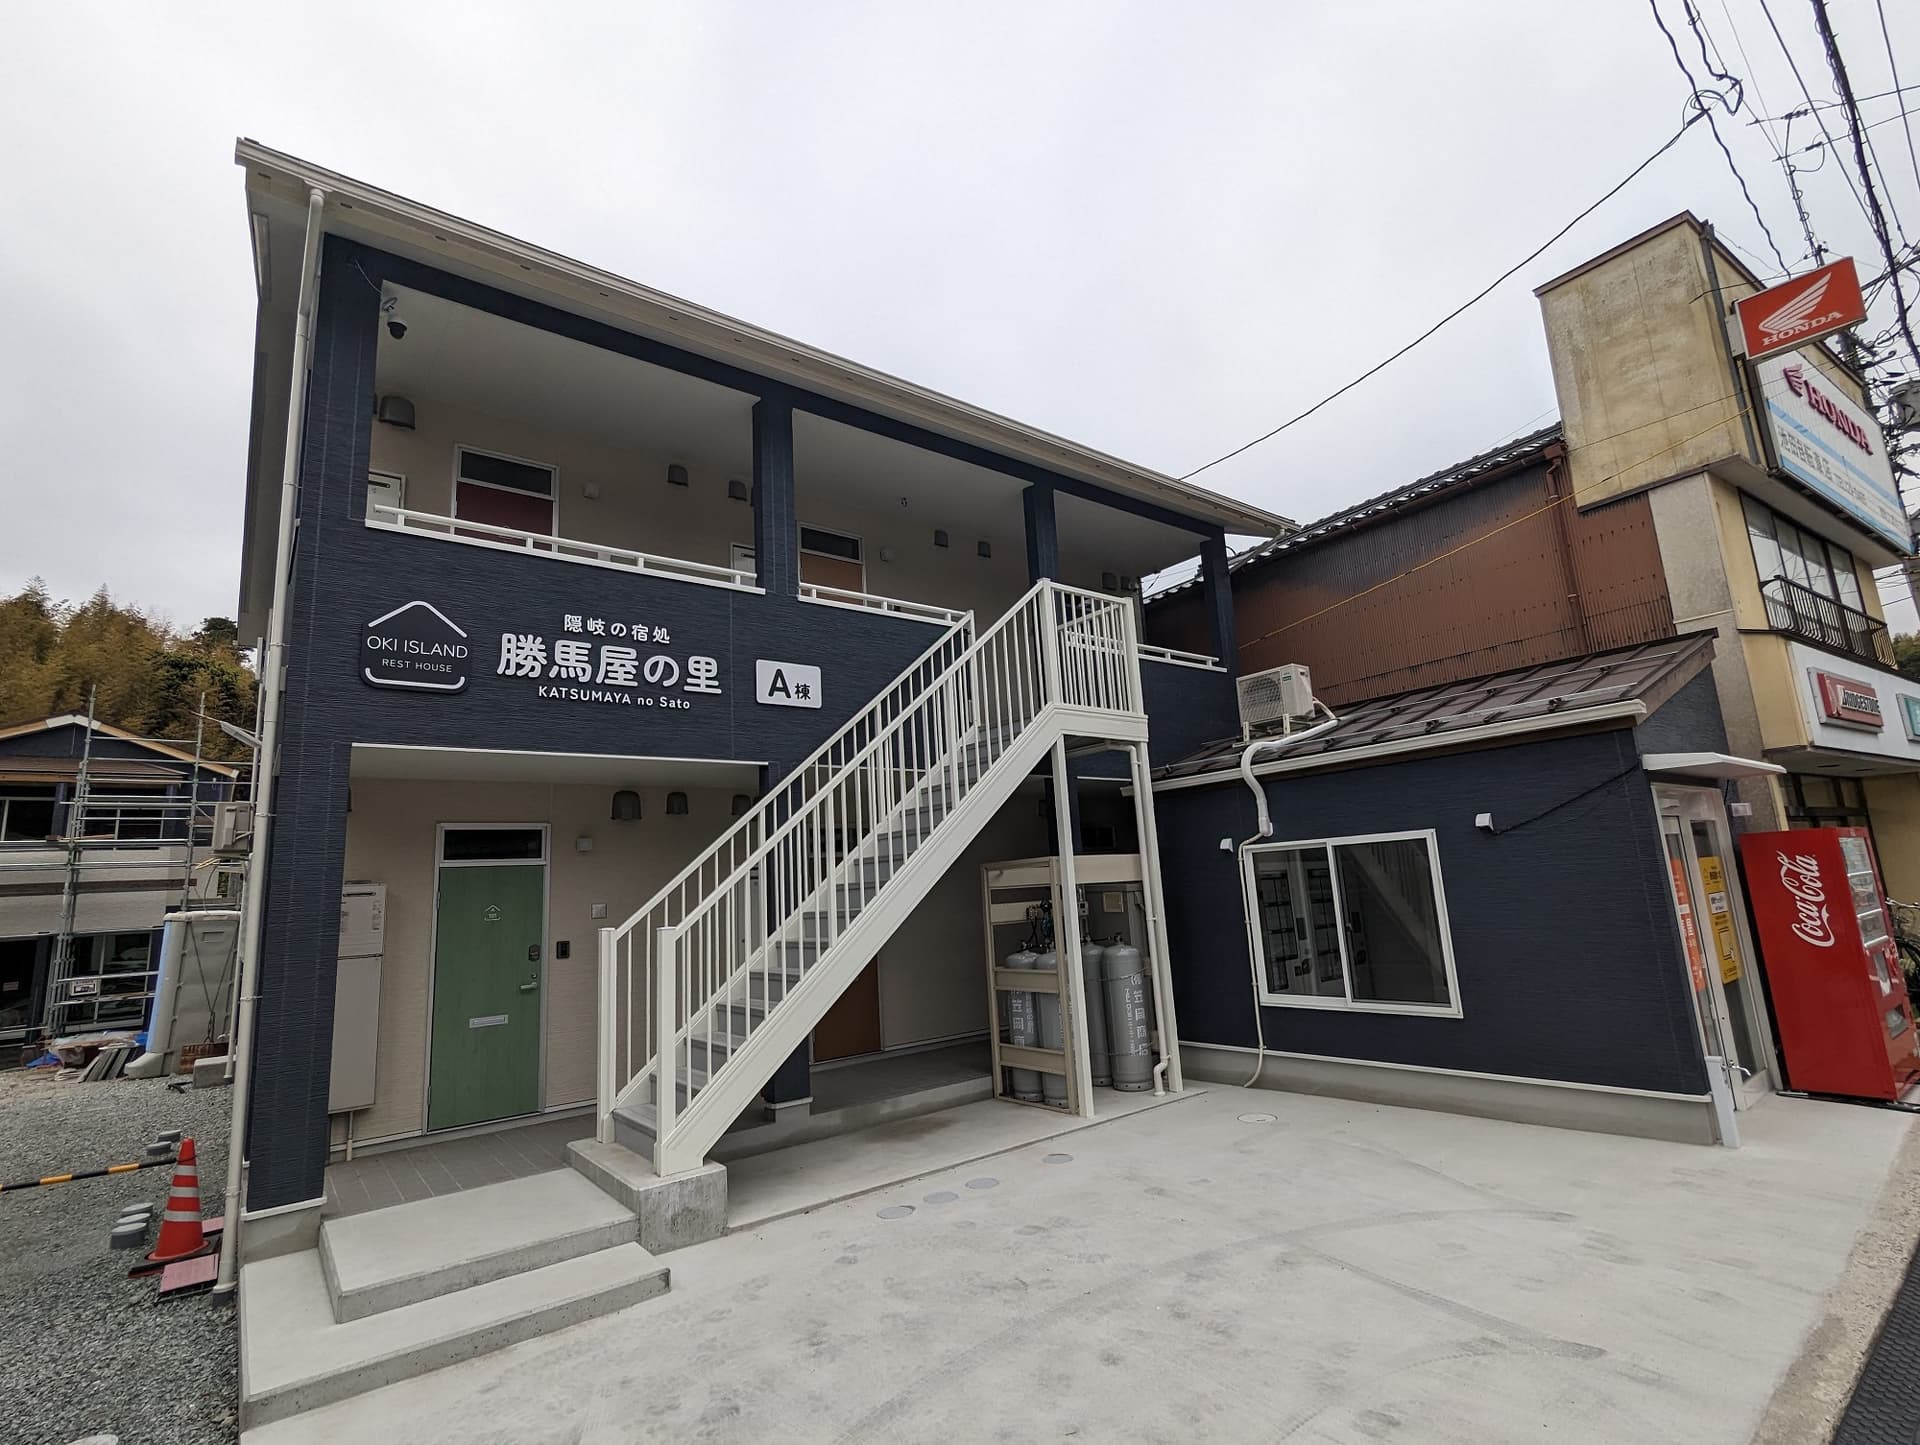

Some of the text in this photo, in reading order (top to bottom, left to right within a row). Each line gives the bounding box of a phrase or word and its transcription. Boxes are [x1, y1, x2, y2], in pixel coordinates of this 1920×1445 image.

[1762, 311, 1843, 346] HONDA
[1803, 379, 1874, 456] HONDA
[564, 614, 670, 644] 隠岐の宿処
[367, 635, 468, 659] OKI ISLAND
[382, 658, 453, 673] REST HOUSE
[497, 633, 722, 694] 勝馬屋の里
[538, 686, 690, 709] KATSUMAYA no Sato
